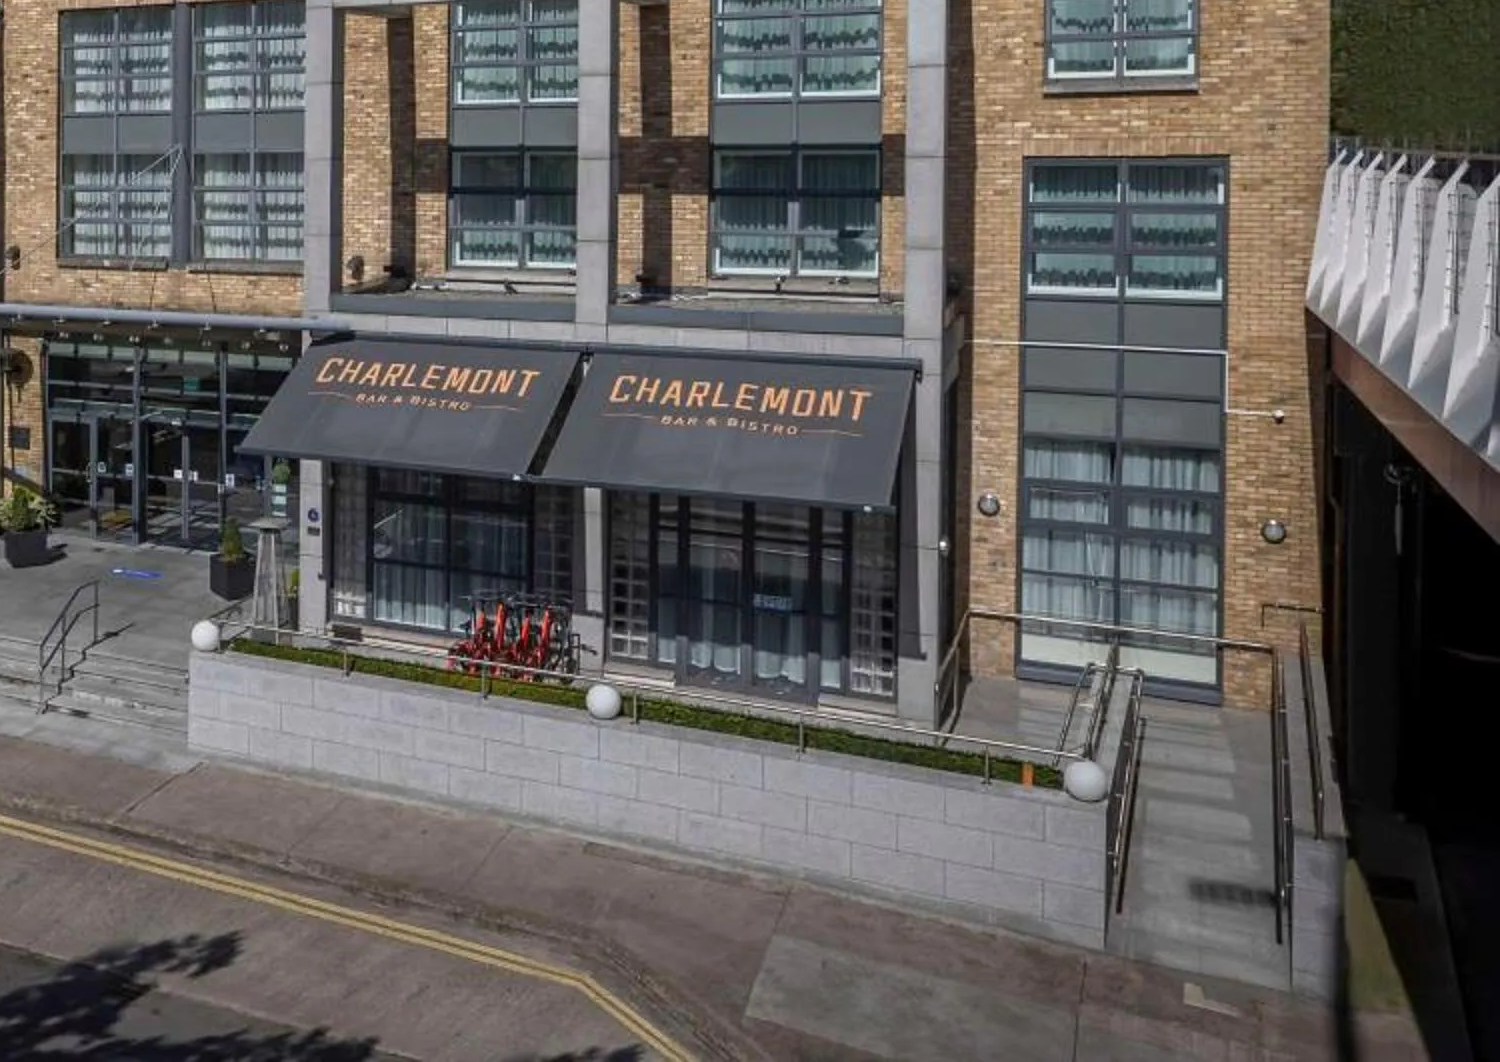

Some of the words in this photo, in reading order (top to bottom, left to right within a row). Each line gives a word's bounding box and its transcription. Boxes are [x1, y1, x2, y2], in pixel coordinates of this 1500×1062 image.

[316, 357, 541, 397] CHARLEMONT
[609, 375, 873, 421] CHARLEMONT
[660, 416, 699, 426] BAR
[727, 418, 799, 436] BISTRO
